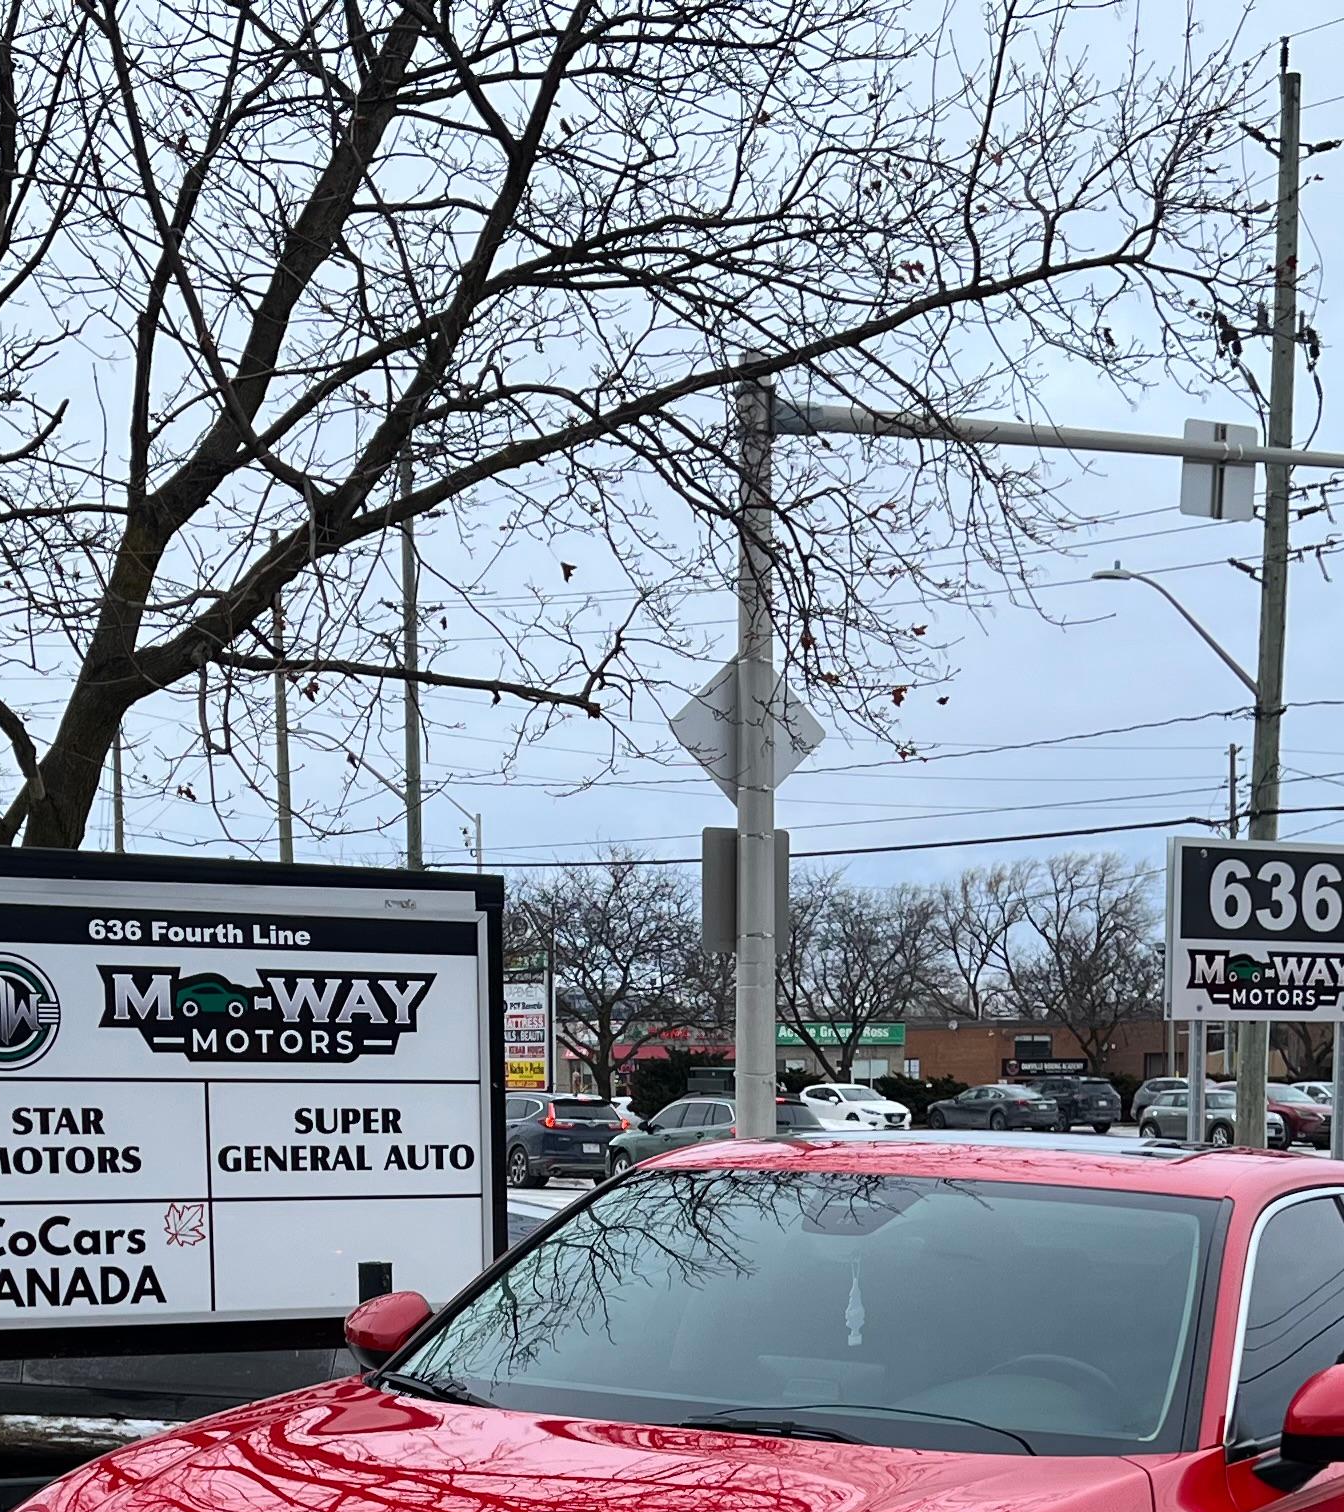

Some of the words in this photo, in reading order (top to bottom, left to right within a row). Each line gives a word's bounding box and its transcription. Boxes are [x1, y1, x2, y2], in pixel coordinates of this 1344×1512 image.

[1209, 858, 1344, 933] 636
[88, 919, 142, 941] 636
[151, 921, 244, 944] Fourth
[252, 924, 311, 946] Line
[1232, 989, 1316, 1006] MOTORS
[506, 1017, 544, 1028] ATTRESS
[862, 1026, 889, 1038] Ross
[192, 1029, 354, 1055] MOTORS
[11, 1107, 106, 1136] STAR
[294, 1107, 403, 1135] SUPER
[217, 1144, 373, 1173] GENERAL
[383, 1144, 475, 1171] AUTO
